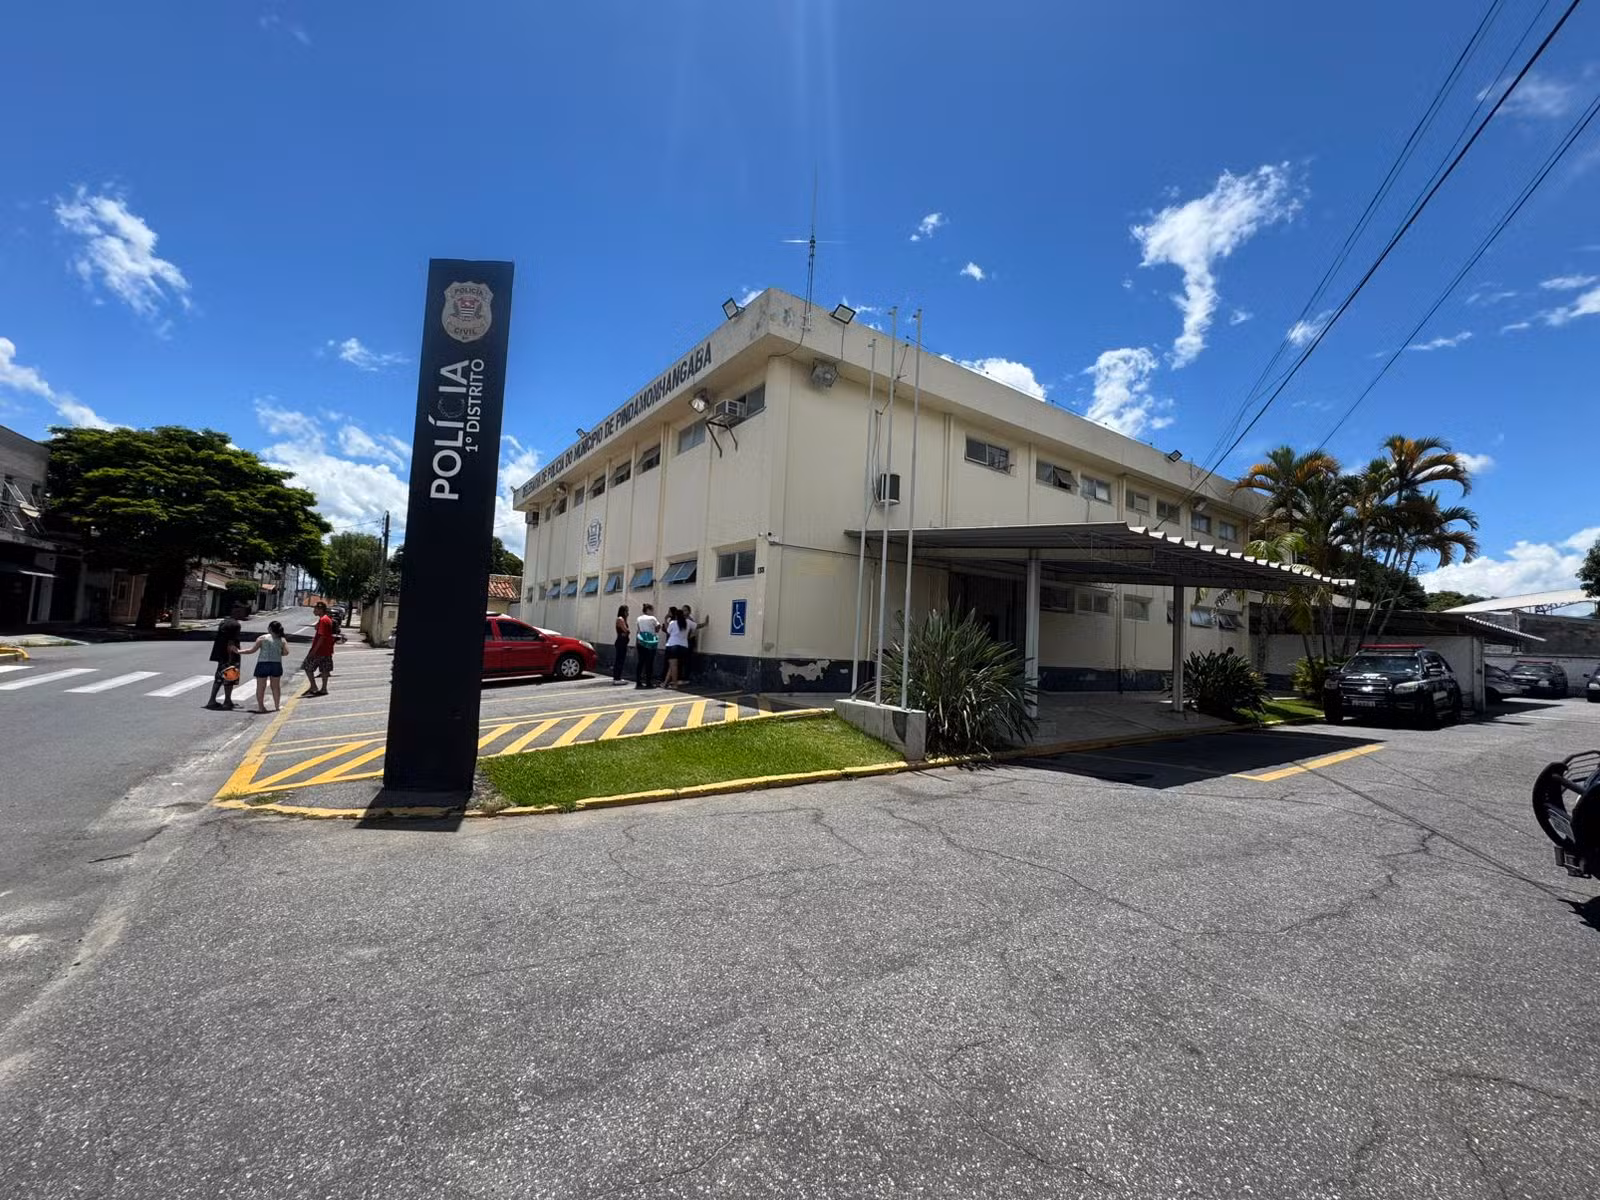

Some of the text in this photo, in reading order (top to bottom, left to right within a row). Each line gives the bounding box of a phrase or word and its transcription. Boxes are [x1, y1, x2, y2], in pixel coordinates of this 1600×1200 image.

[454, 327, 478, 335] CIVIL
[466, 358, 485, 433] DISTRITO
[604, 417, 614, 439] DE
[616, 341, 712, 431] PINDAMONHANGABA
